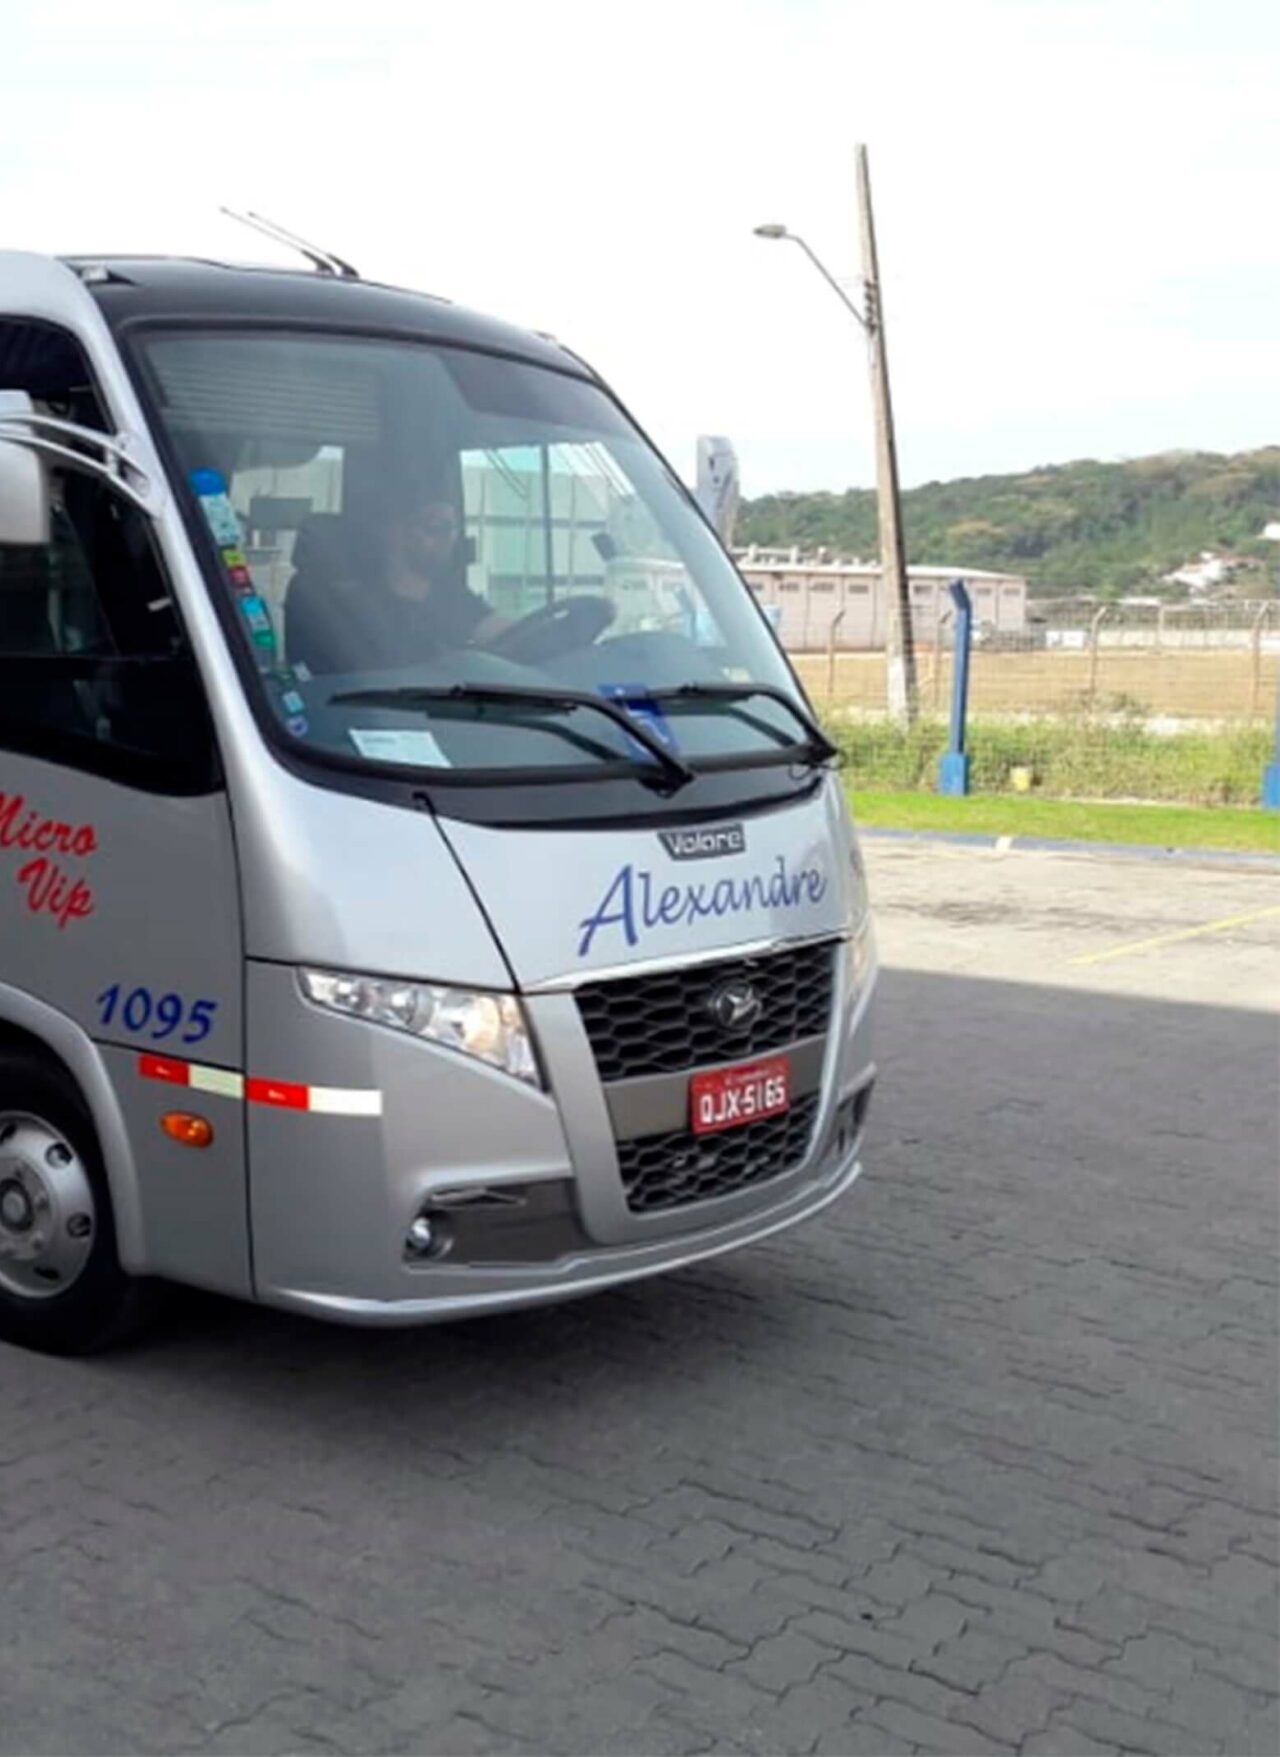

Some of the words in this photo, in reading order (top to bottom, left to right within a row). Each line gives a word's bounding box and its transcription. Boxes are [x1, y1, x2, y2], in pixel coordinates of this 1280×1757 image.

[665, 831, 741, 855] Volare
[17, 857, 93, 930] Vip
[578, 856, 827, 956] Alexandre
[96, 984, 218, 1043] 1095
